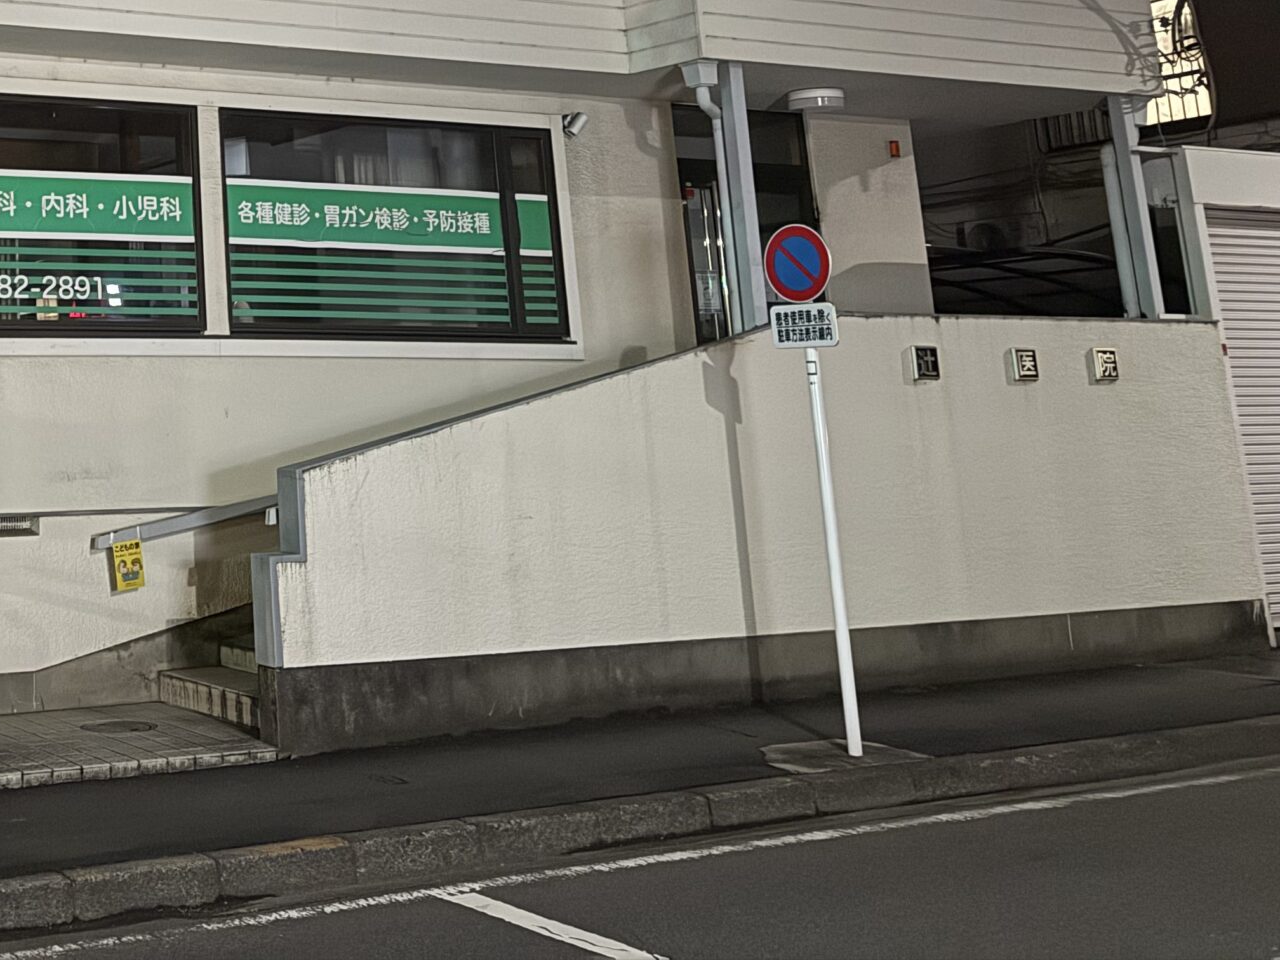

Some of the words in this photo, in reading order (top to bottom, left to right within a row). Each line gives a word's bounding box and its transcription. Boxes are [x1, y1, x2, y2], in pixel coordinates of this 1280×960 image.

[237, 200, 491, 235] 各種健診・胃ガン検診・予防接種
[918, 349, 937, 377] 辻
[1018, 351, 1037, 376] 医
[1098, 351, 1117, 377] 院
